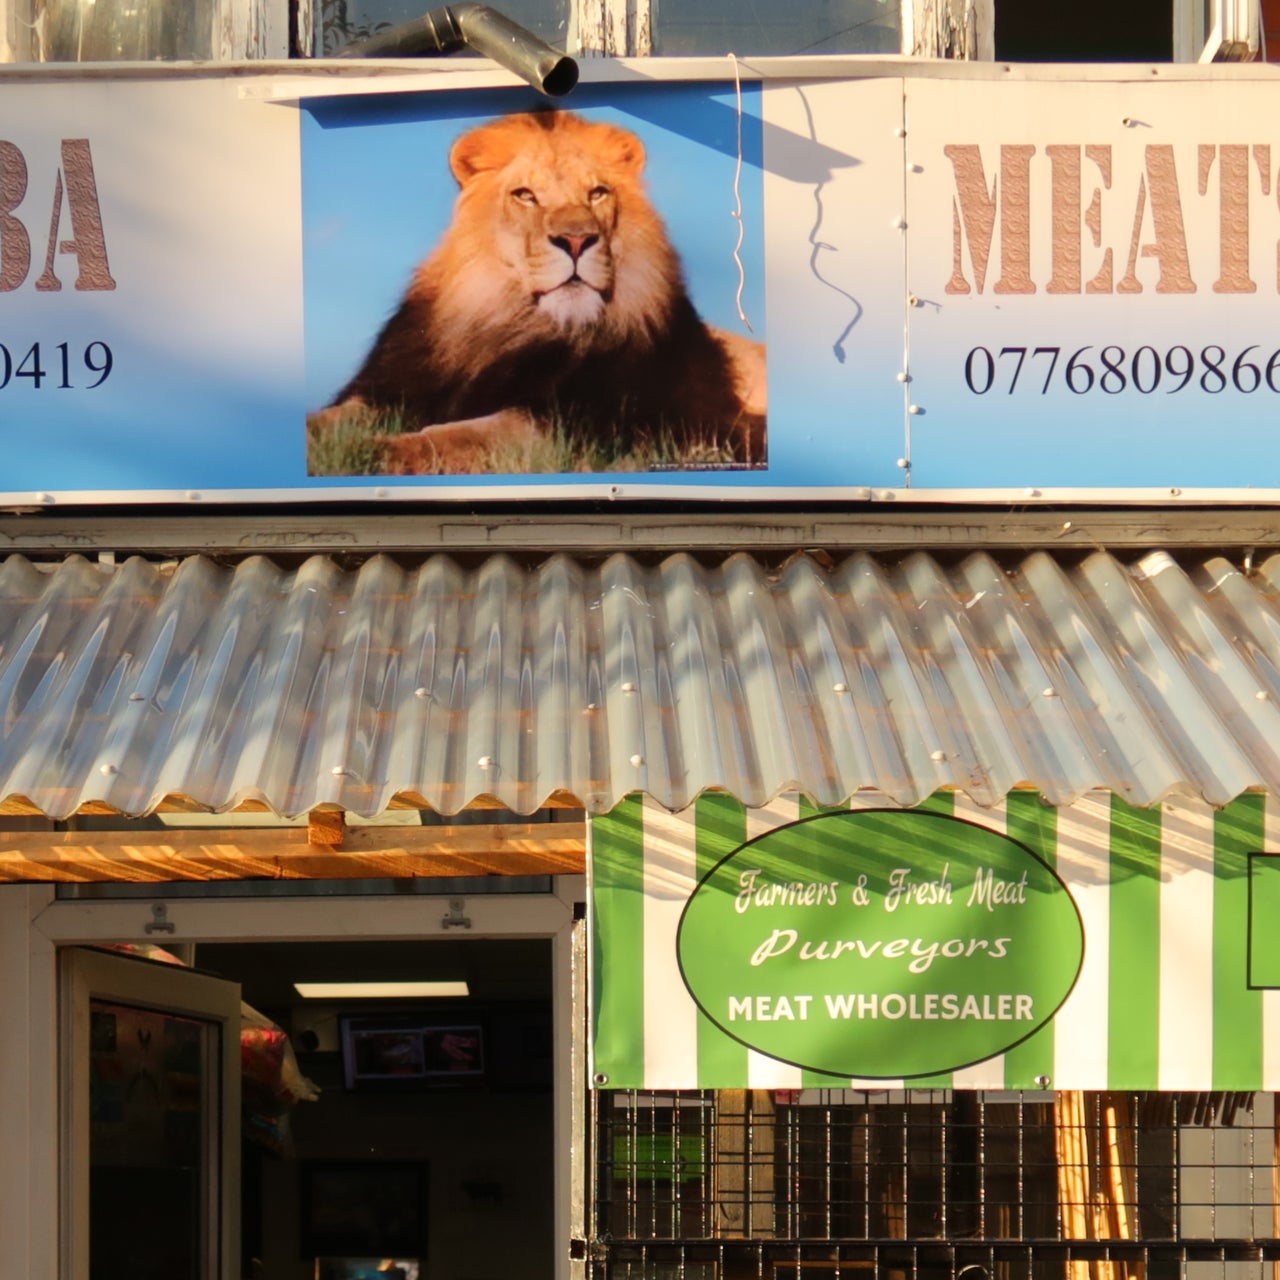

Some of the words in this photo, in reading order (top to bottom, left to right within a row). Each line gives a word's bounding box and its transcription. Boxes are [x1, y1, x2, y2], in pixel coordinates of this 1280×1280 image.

[734, 868, 840, 914] Farmers
[851, 874, 870, 907] &
[883, 863, 954, 913] Fresh
[966, 866, 1029, 912] Meat
[749, 928, 1012, 974] Purveyors
[728, 995, 813, 1021] MEAT
[824, 994, 1034, 1021] WHOLESALER
